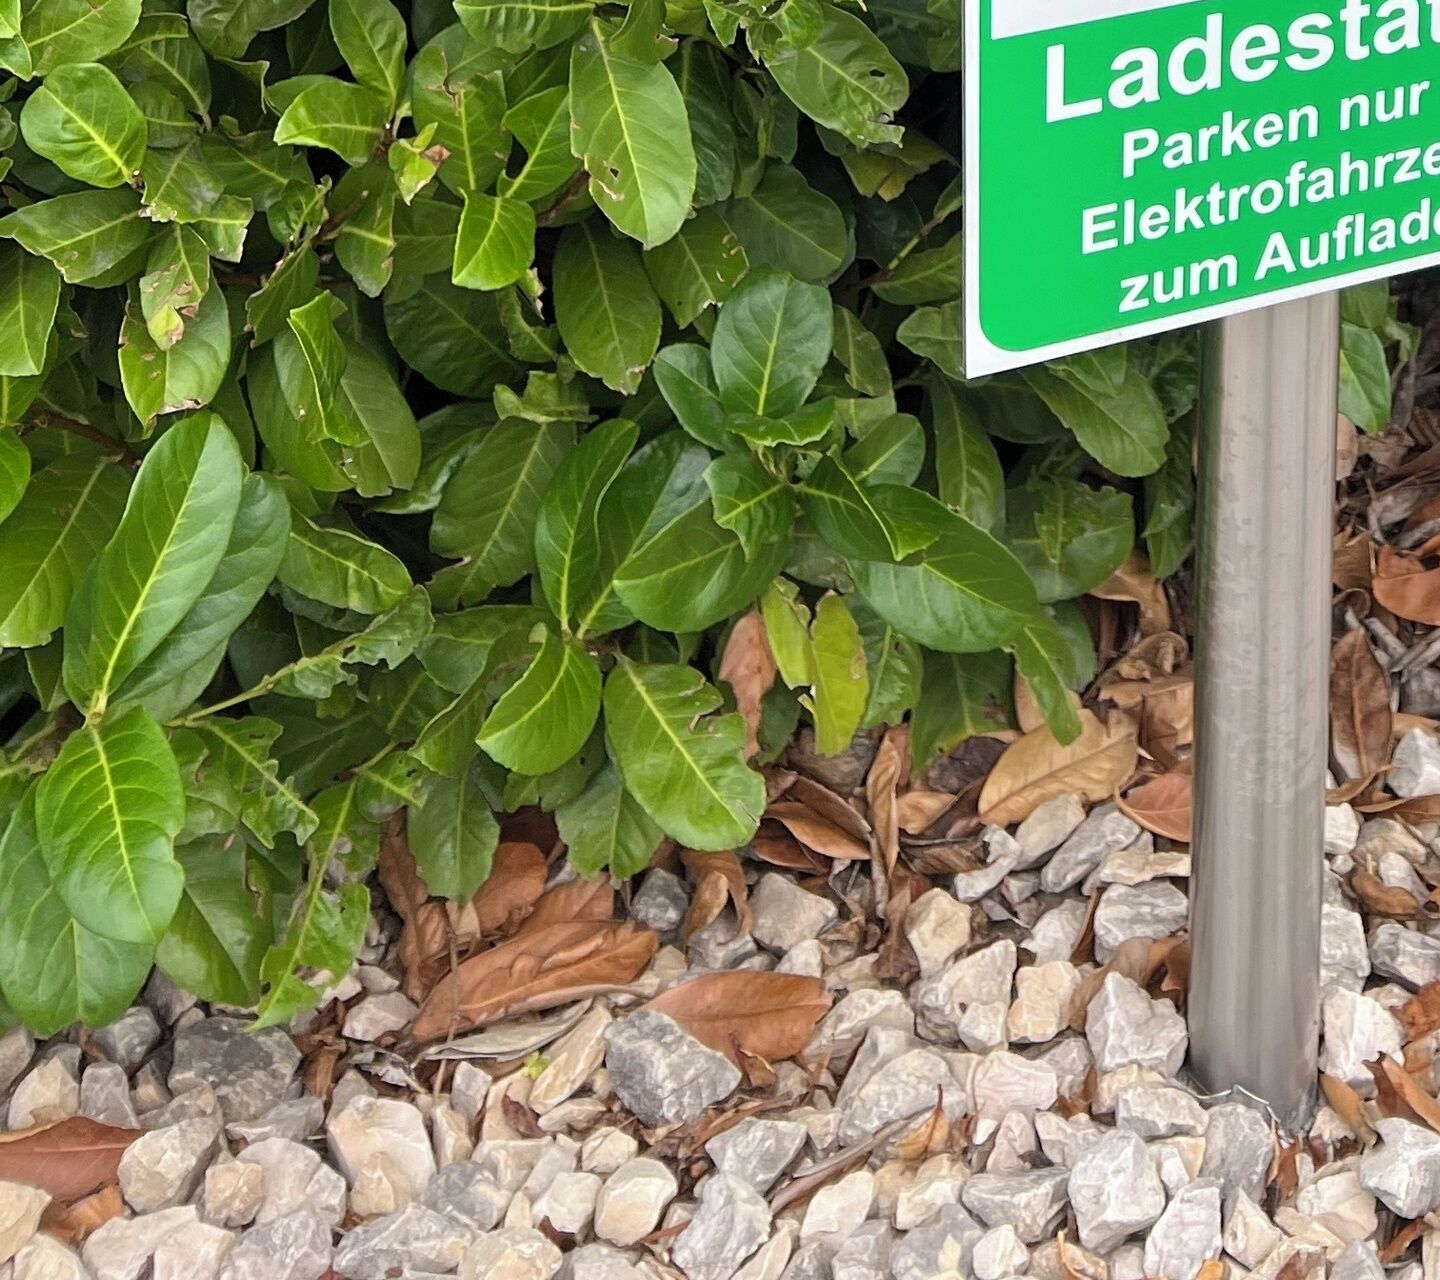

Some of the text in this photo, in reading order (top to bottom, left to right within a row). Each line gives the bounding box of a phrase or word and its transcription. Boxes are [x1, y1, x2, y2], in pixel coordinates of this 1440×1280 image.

[1122, 101, 1319, 178] Parken
[1339, 80, 1430, 132] nur
[1118, 259, 1239, 313] zum
